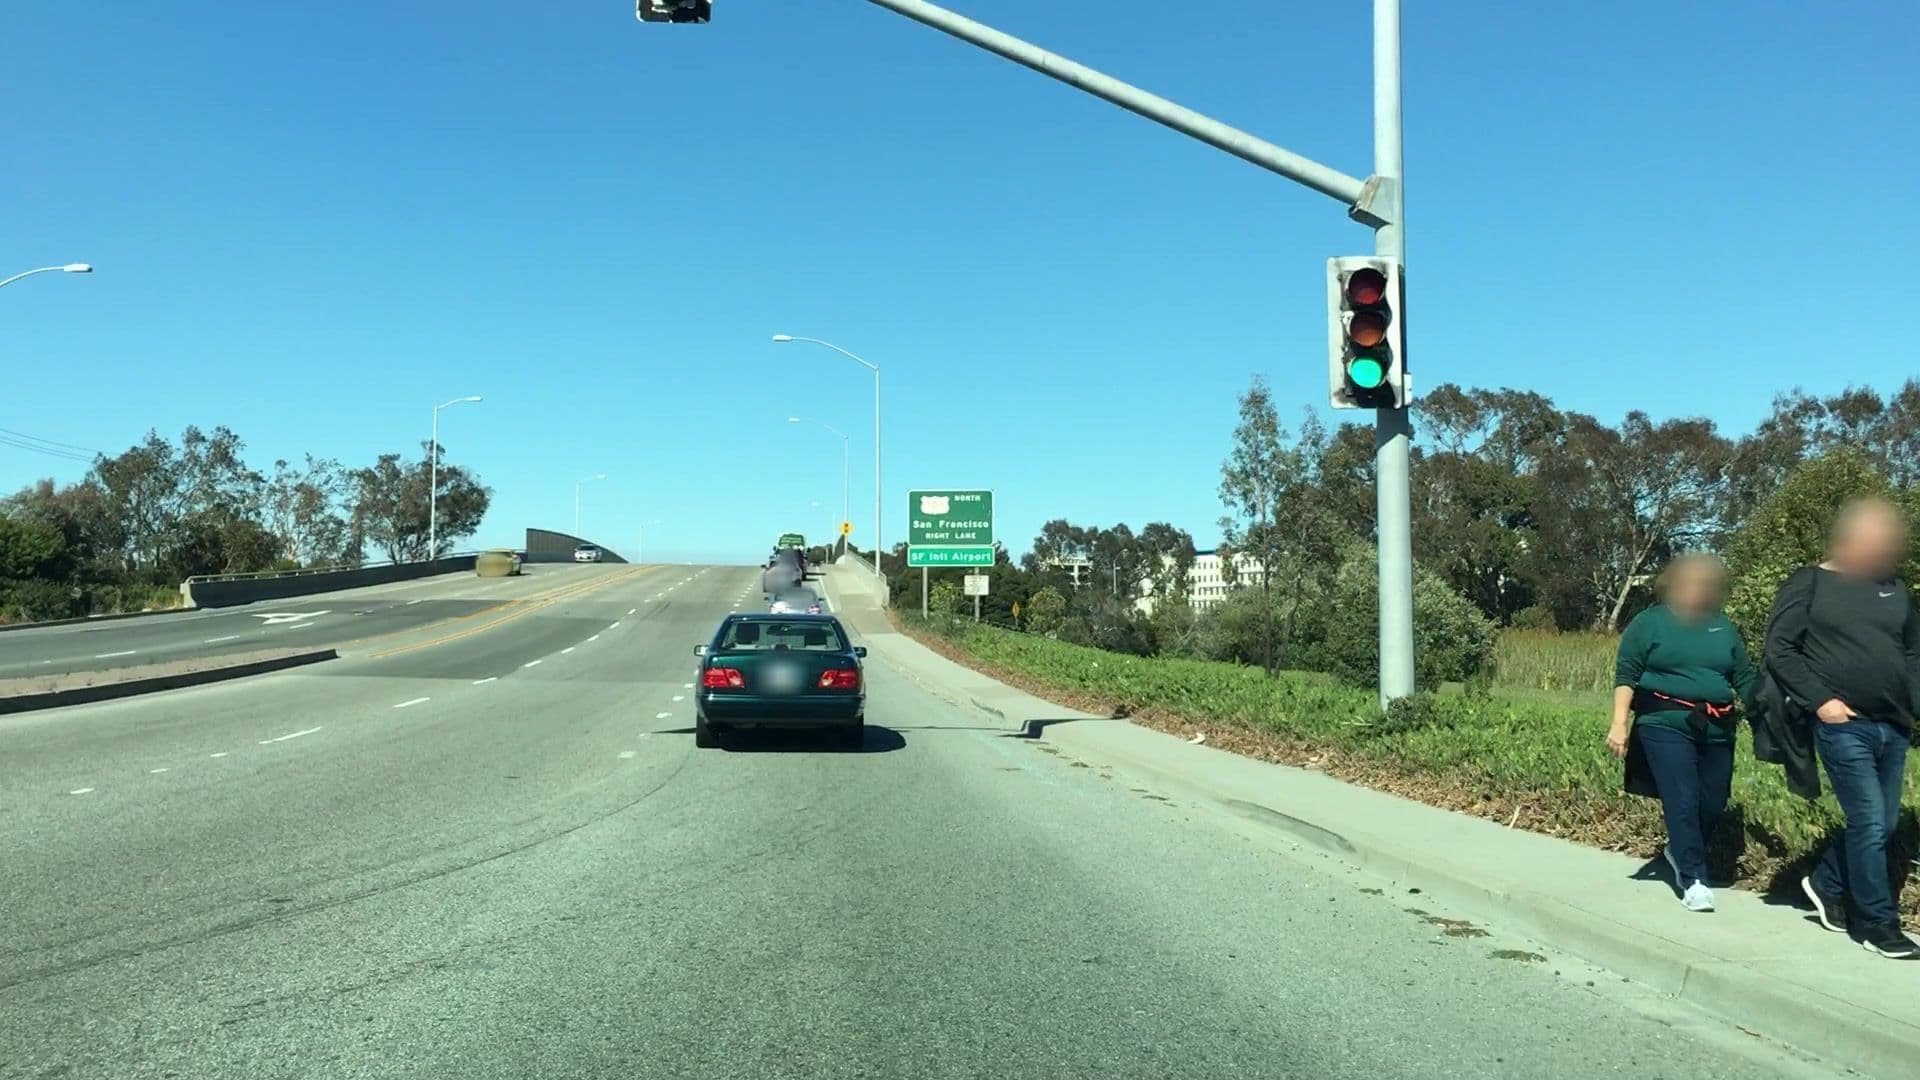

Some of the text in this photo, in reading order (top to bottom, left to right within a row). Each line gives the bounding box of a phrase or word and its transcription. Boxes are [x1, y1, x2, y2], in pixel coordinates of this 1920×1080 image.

[913, 520, 989, 528] San Francisco
[911, 552, 925, 561] SF
[951, 552, 991, 562] Airport
